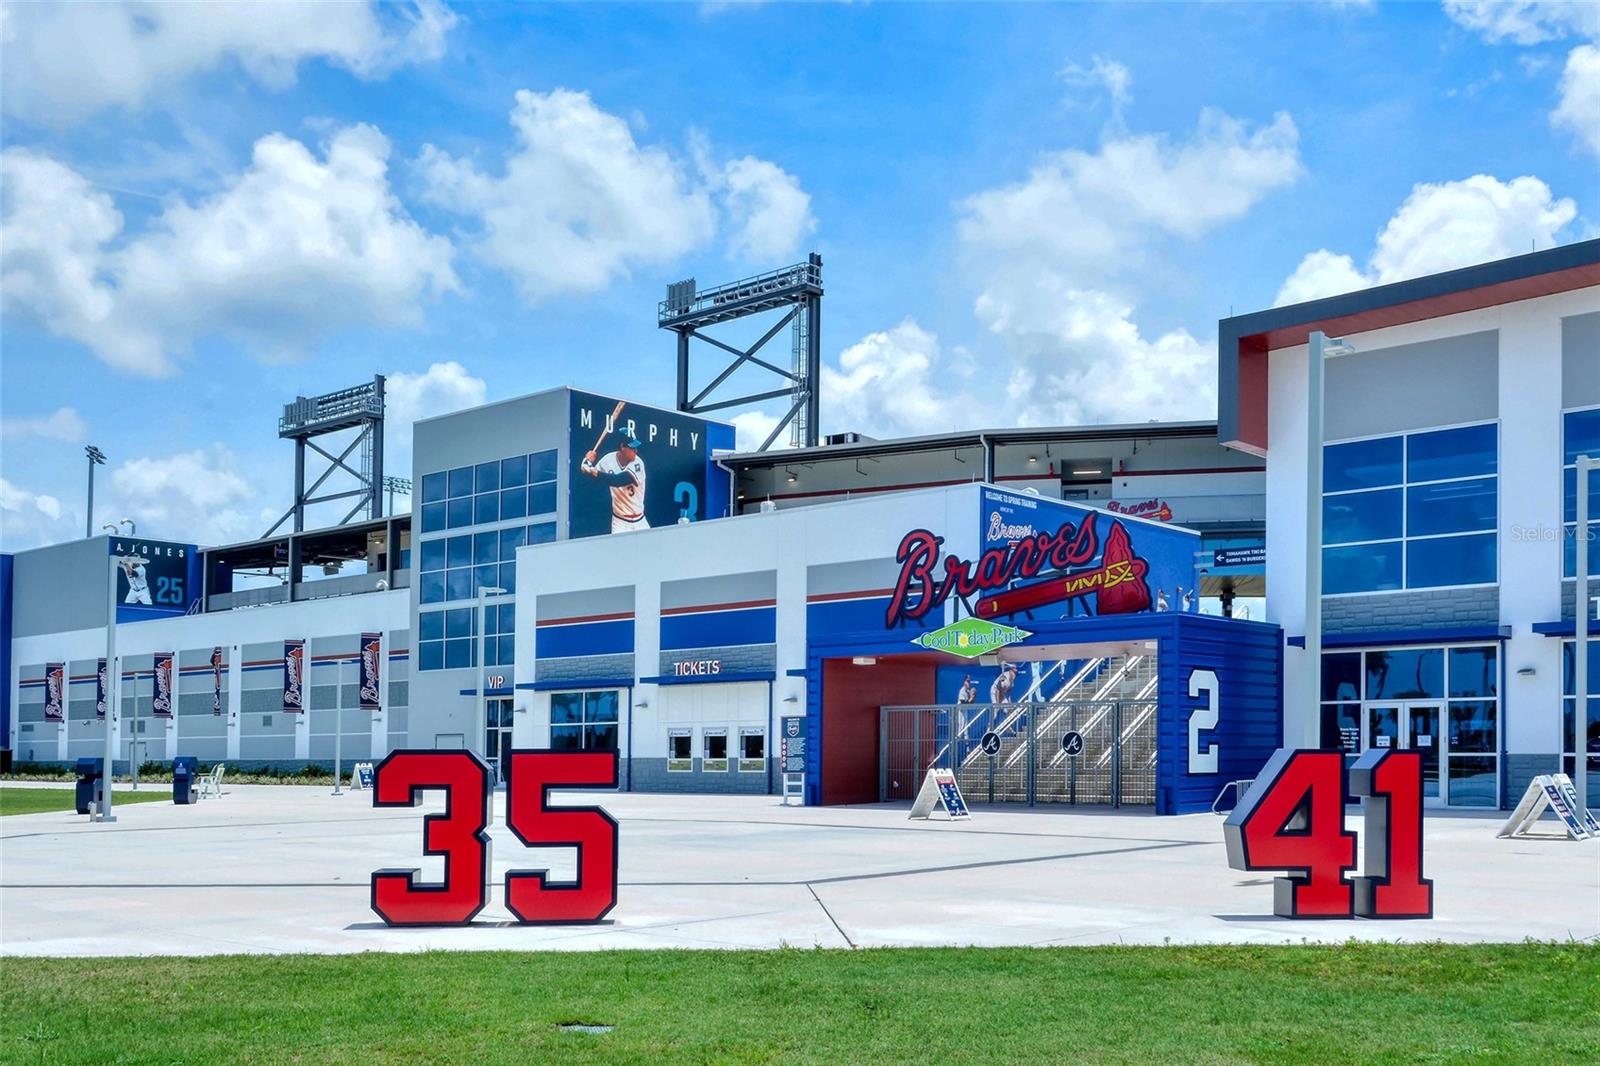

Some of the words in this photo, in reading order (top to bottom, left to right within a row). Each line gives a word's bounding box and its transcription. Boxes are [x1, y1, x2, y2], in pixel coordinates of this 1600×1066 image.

[581, 408, 699, 450] MURPHY
[674, 481, 698, 522] 3
[987, 511, 1032, 541] Braves
[131, 544, 184, 558] JONES
[886, 510, 1099, 629] Braves
[156, 576, 184, 604] 25
[992, 626, 1023, 645] Park
[284, 656, 302, 706] Braves
[361, 650, 379, 702] Braves
[487, 675, 504, 689] VIP
[673, 660, 721, 676] TICKETS
[153, 667, 171, 713] Braves
[1188, 669, 1219, 774] 2
[371, 749, 619, 927] 35
[1226, 748, 1433, 919] 41
